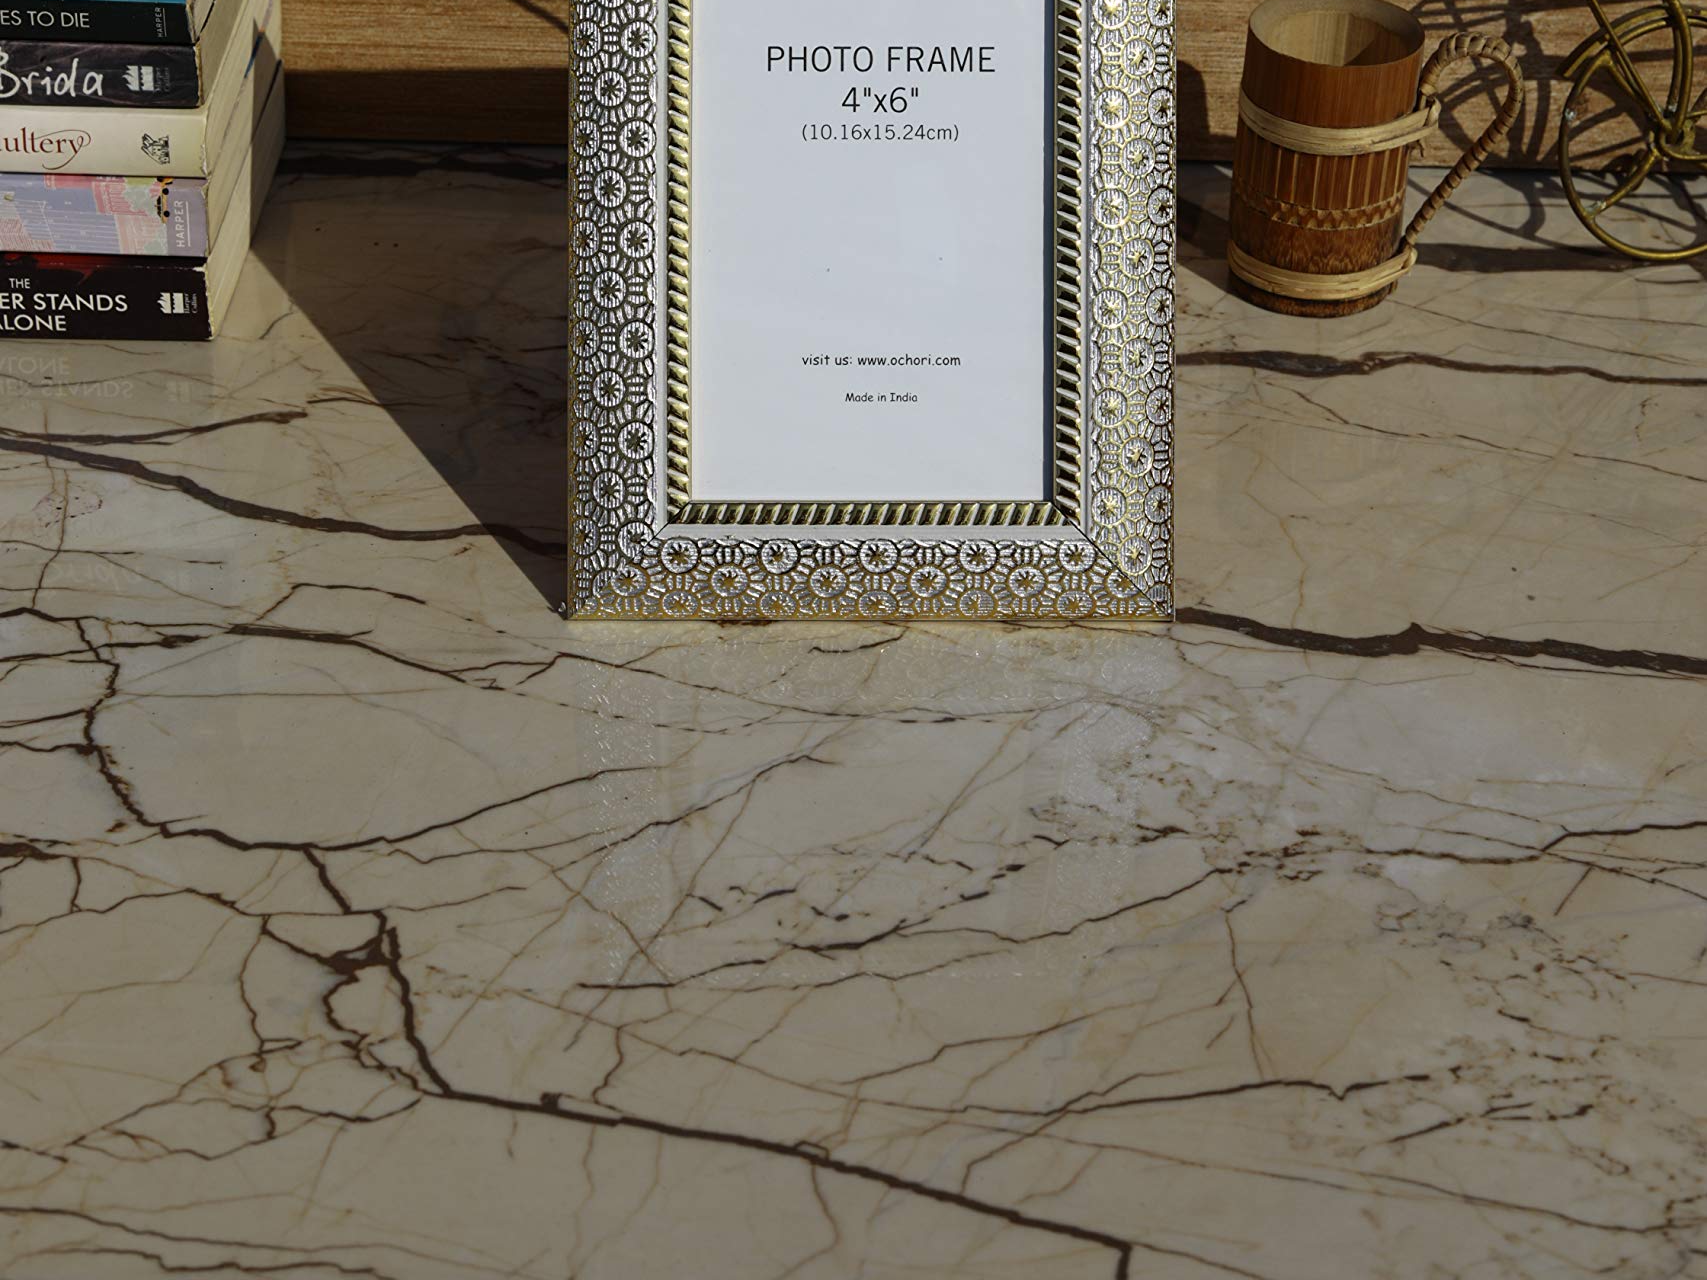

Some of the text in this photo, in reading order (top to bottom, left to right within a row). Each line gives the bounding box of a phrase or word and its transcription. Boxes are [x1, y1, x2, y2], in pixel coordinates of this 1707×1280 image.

[0, 10, 90, 28] ES TO DIE
[154, 7, 163, 38] HARPER
[767, 46, 996, 72] PHOTO FRAME
[841, 86, 919, 113] 4"x6"
[802, 124, 959, 142] (10.16x15.24cm)
[0, 127, 92, 171] ultery
[174, 200, 186, 248] HARPER
[9, 278, 31, 289] THE
[34, 293, 128, 312] STANDS
[0, 314, 67, 331] LONE
[802, 354, 961, 366] visit us: www.ochori.com
[845, 392, 918, 402] Made in India
